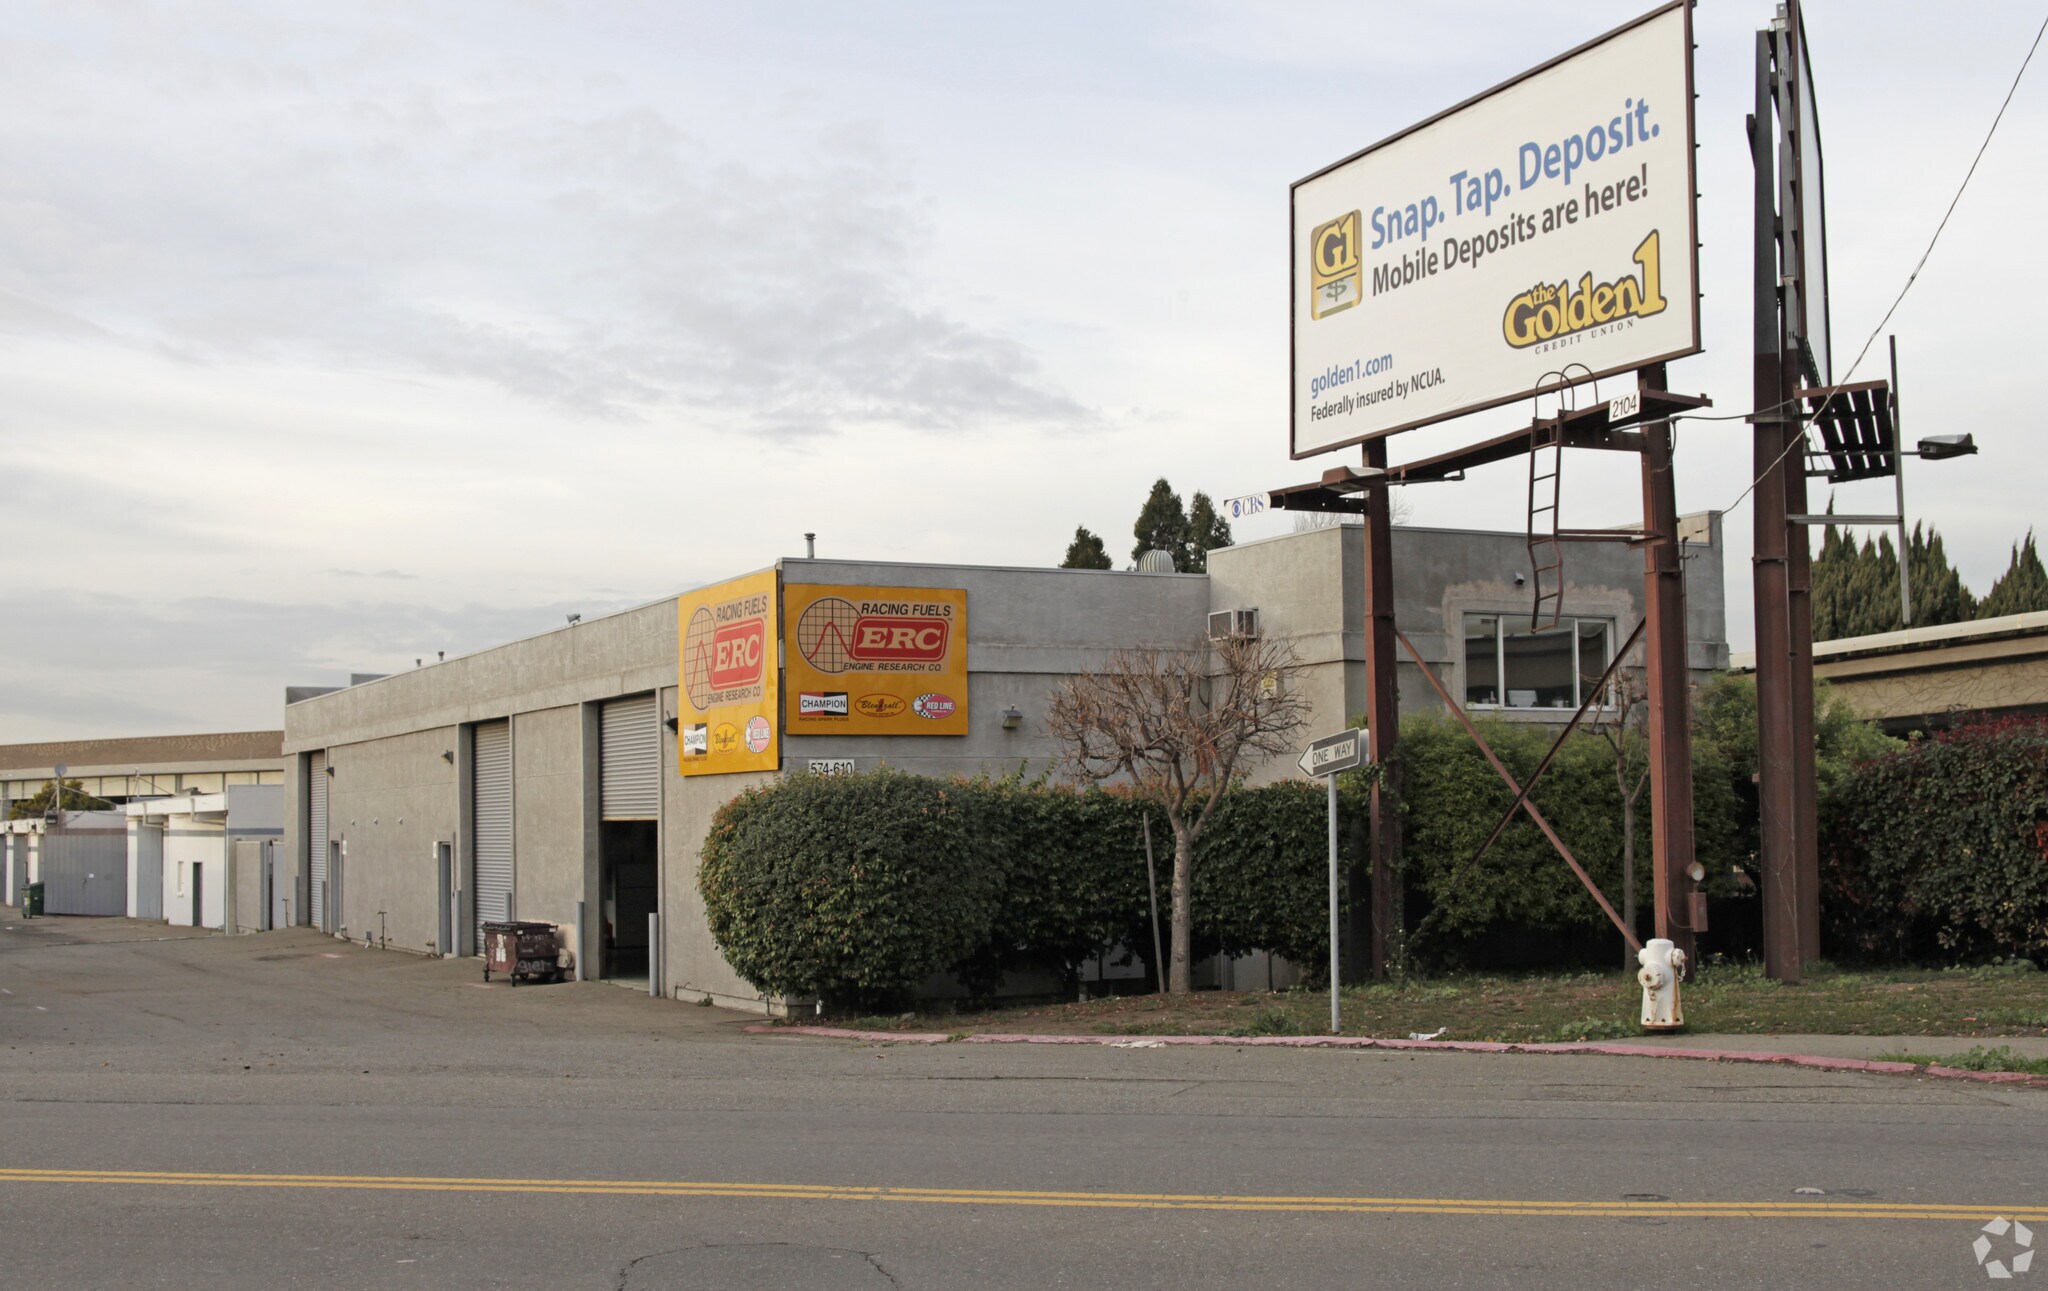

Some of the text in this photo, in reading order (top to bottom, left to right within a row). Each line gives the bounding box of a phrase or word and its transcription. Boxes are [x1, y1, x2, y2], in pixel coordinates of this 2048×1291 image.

[1371, 97, 1660, 250] Snap. Tap. Deposit.
[1372, 162, 1648, 297] Mobile Deposits are here!
[1532, 281, 1557, 306] the
[1534, 318, 1635, 355] CREDIT UNION
[1311, 353, 1393, 400] golden1.com
[1311, 367, 1446, 422] Federally insured by NCUA.
[1612, 394, 1637, 418] 2104
[1242, 494, 1264, 517] CBS
[716, 595, 767, 624] RACING FUELS
[860, 602, 952, 617] RACING FUELS
[857, 626, 942, 650] ERC
[714, 633, 761, 673] ERC
[842, 662, 875, 671] ENGINE
[877, 662, 925, 672] RESEARCH
[707, 691, 724, 704] ENGINE
[725, 686, 751, 701] RESEARCH
[801, 699, 847, 708] CHAMPION
[926, 701, 954, 710] RED LINE
[684, 734, 706, 746] CHAMPION
[1312, 741, 1353, 766] ONE WAY
